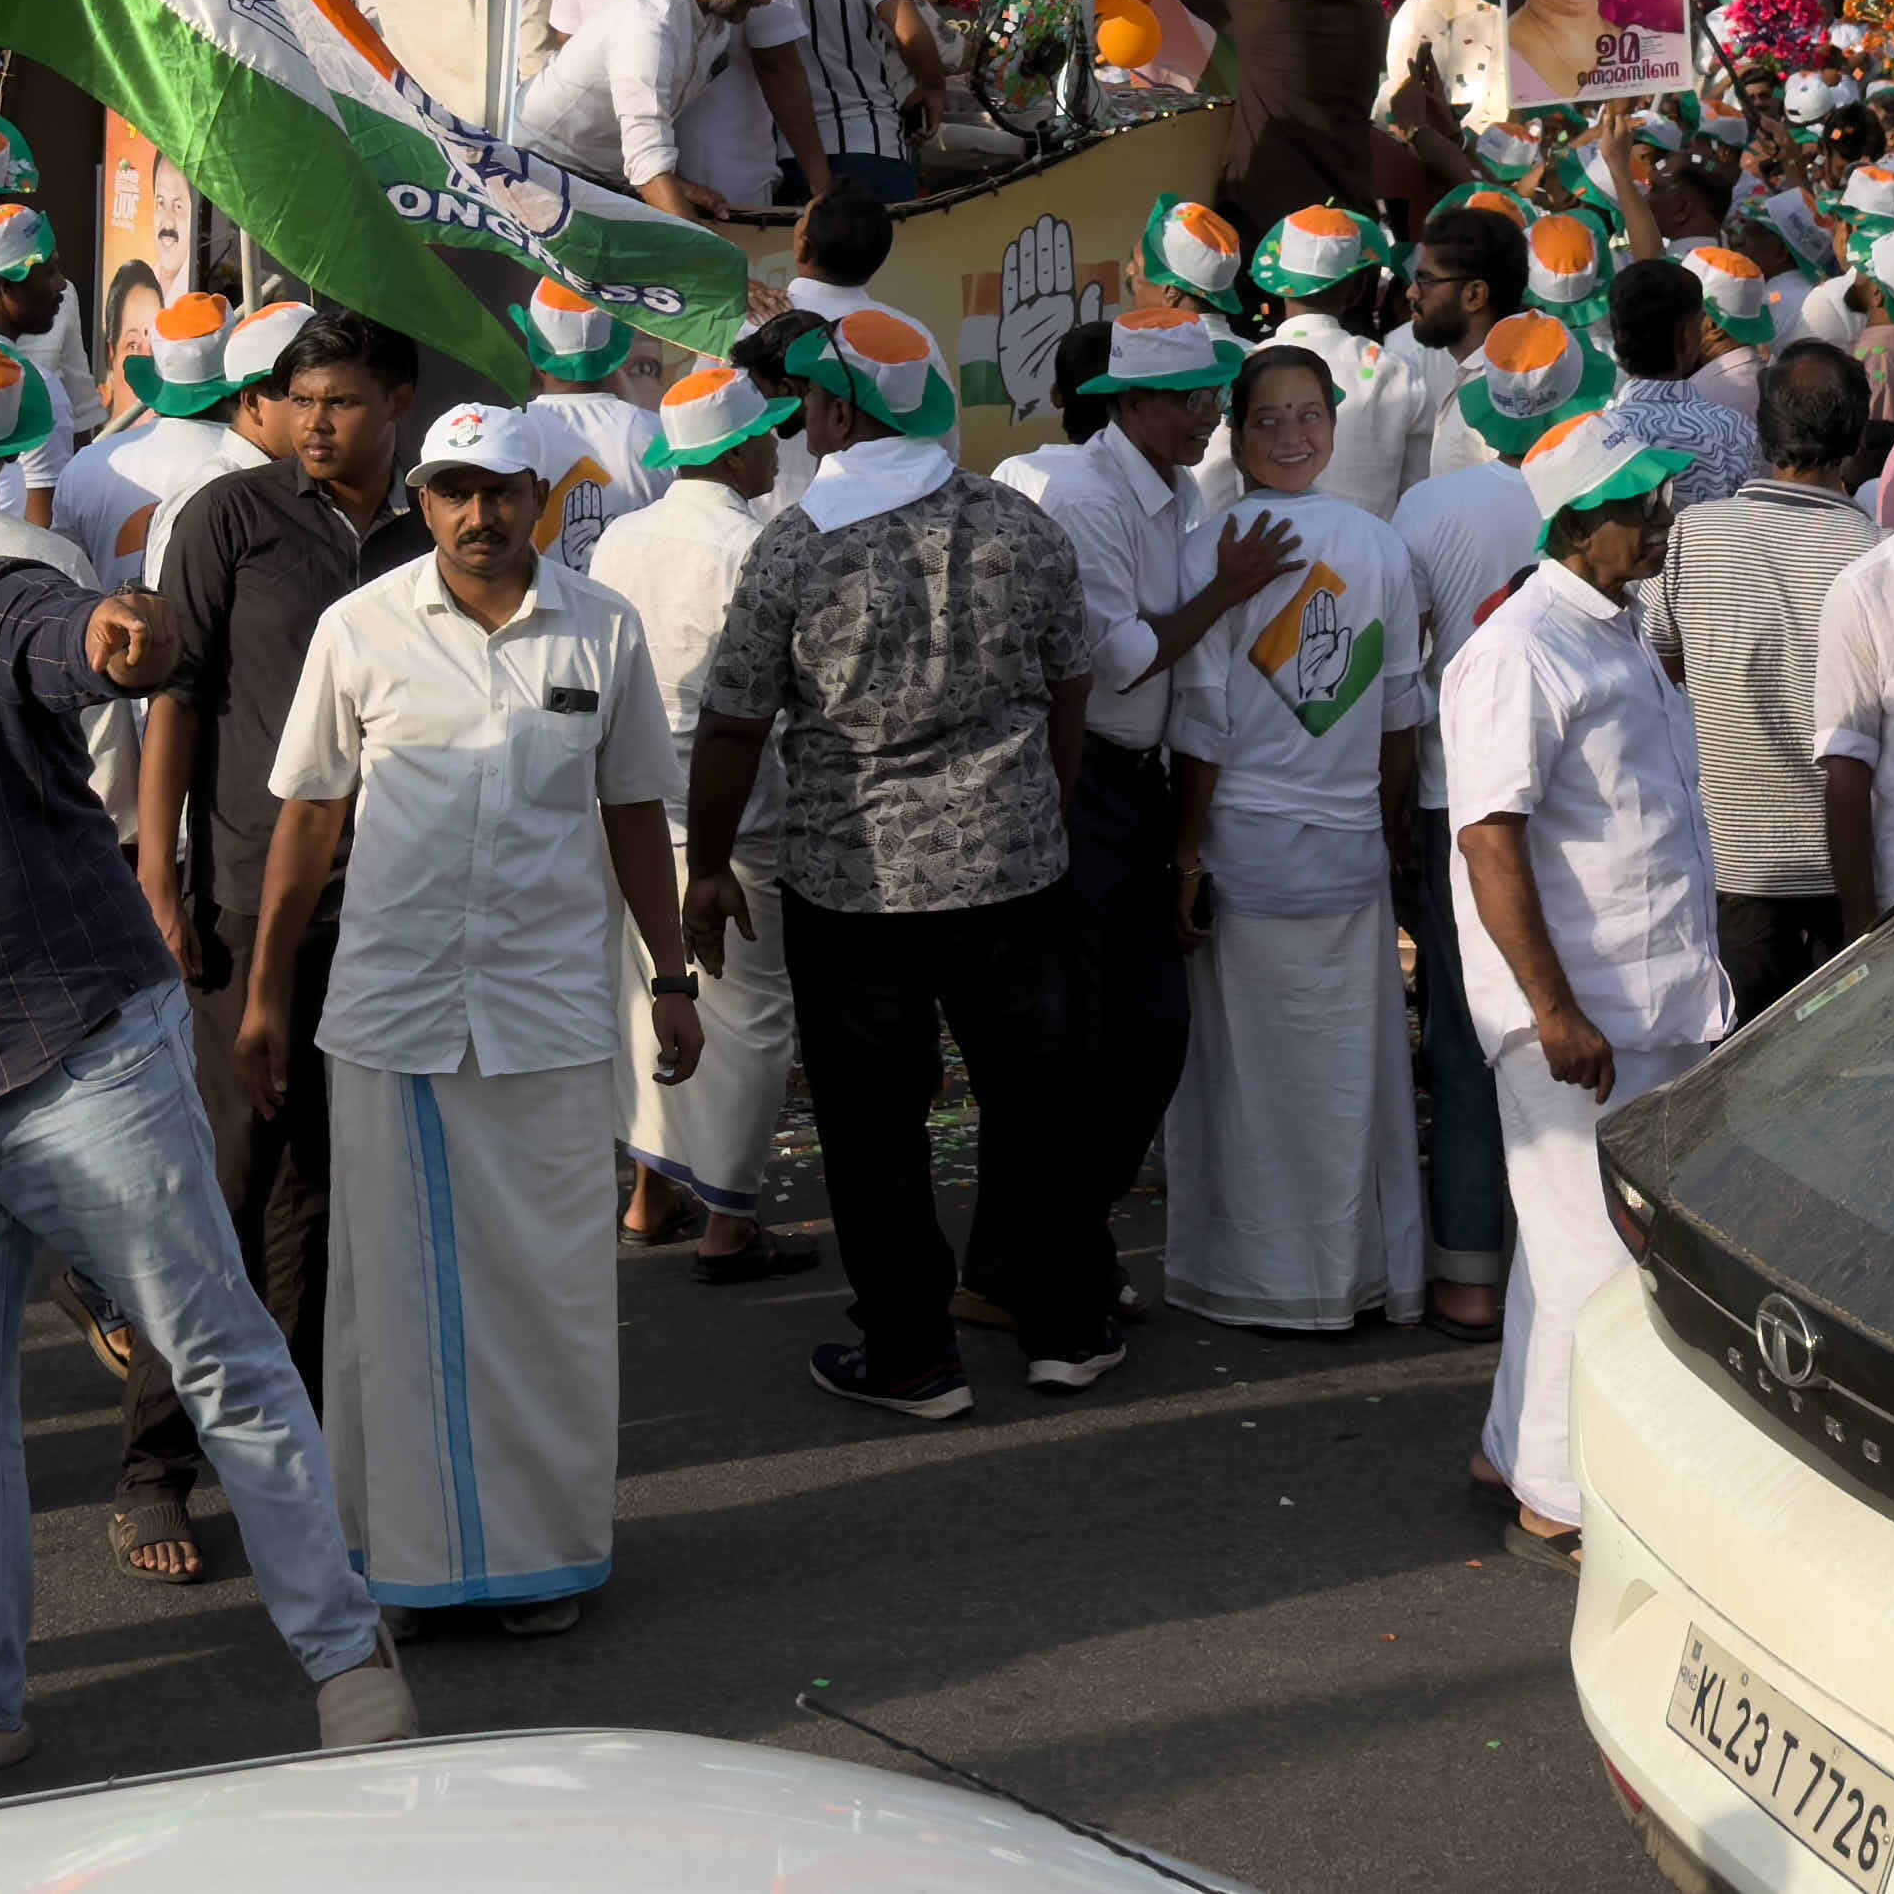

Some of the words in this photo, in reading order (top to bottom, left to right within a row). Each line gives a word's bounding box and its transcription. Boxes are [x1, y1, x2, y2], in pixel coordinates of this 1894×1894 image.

[1576, 56, 1680, 88] തോമസിനെ
[1595, 30, 1641, 67] ഉമ
[384, 182, 686, 317] ONGRESS
[1689, 1664, 1771, 1781] KL23
[1771, 1727, 1799, 1798] T
[1793, 1751, 1888, 1873] 7726
